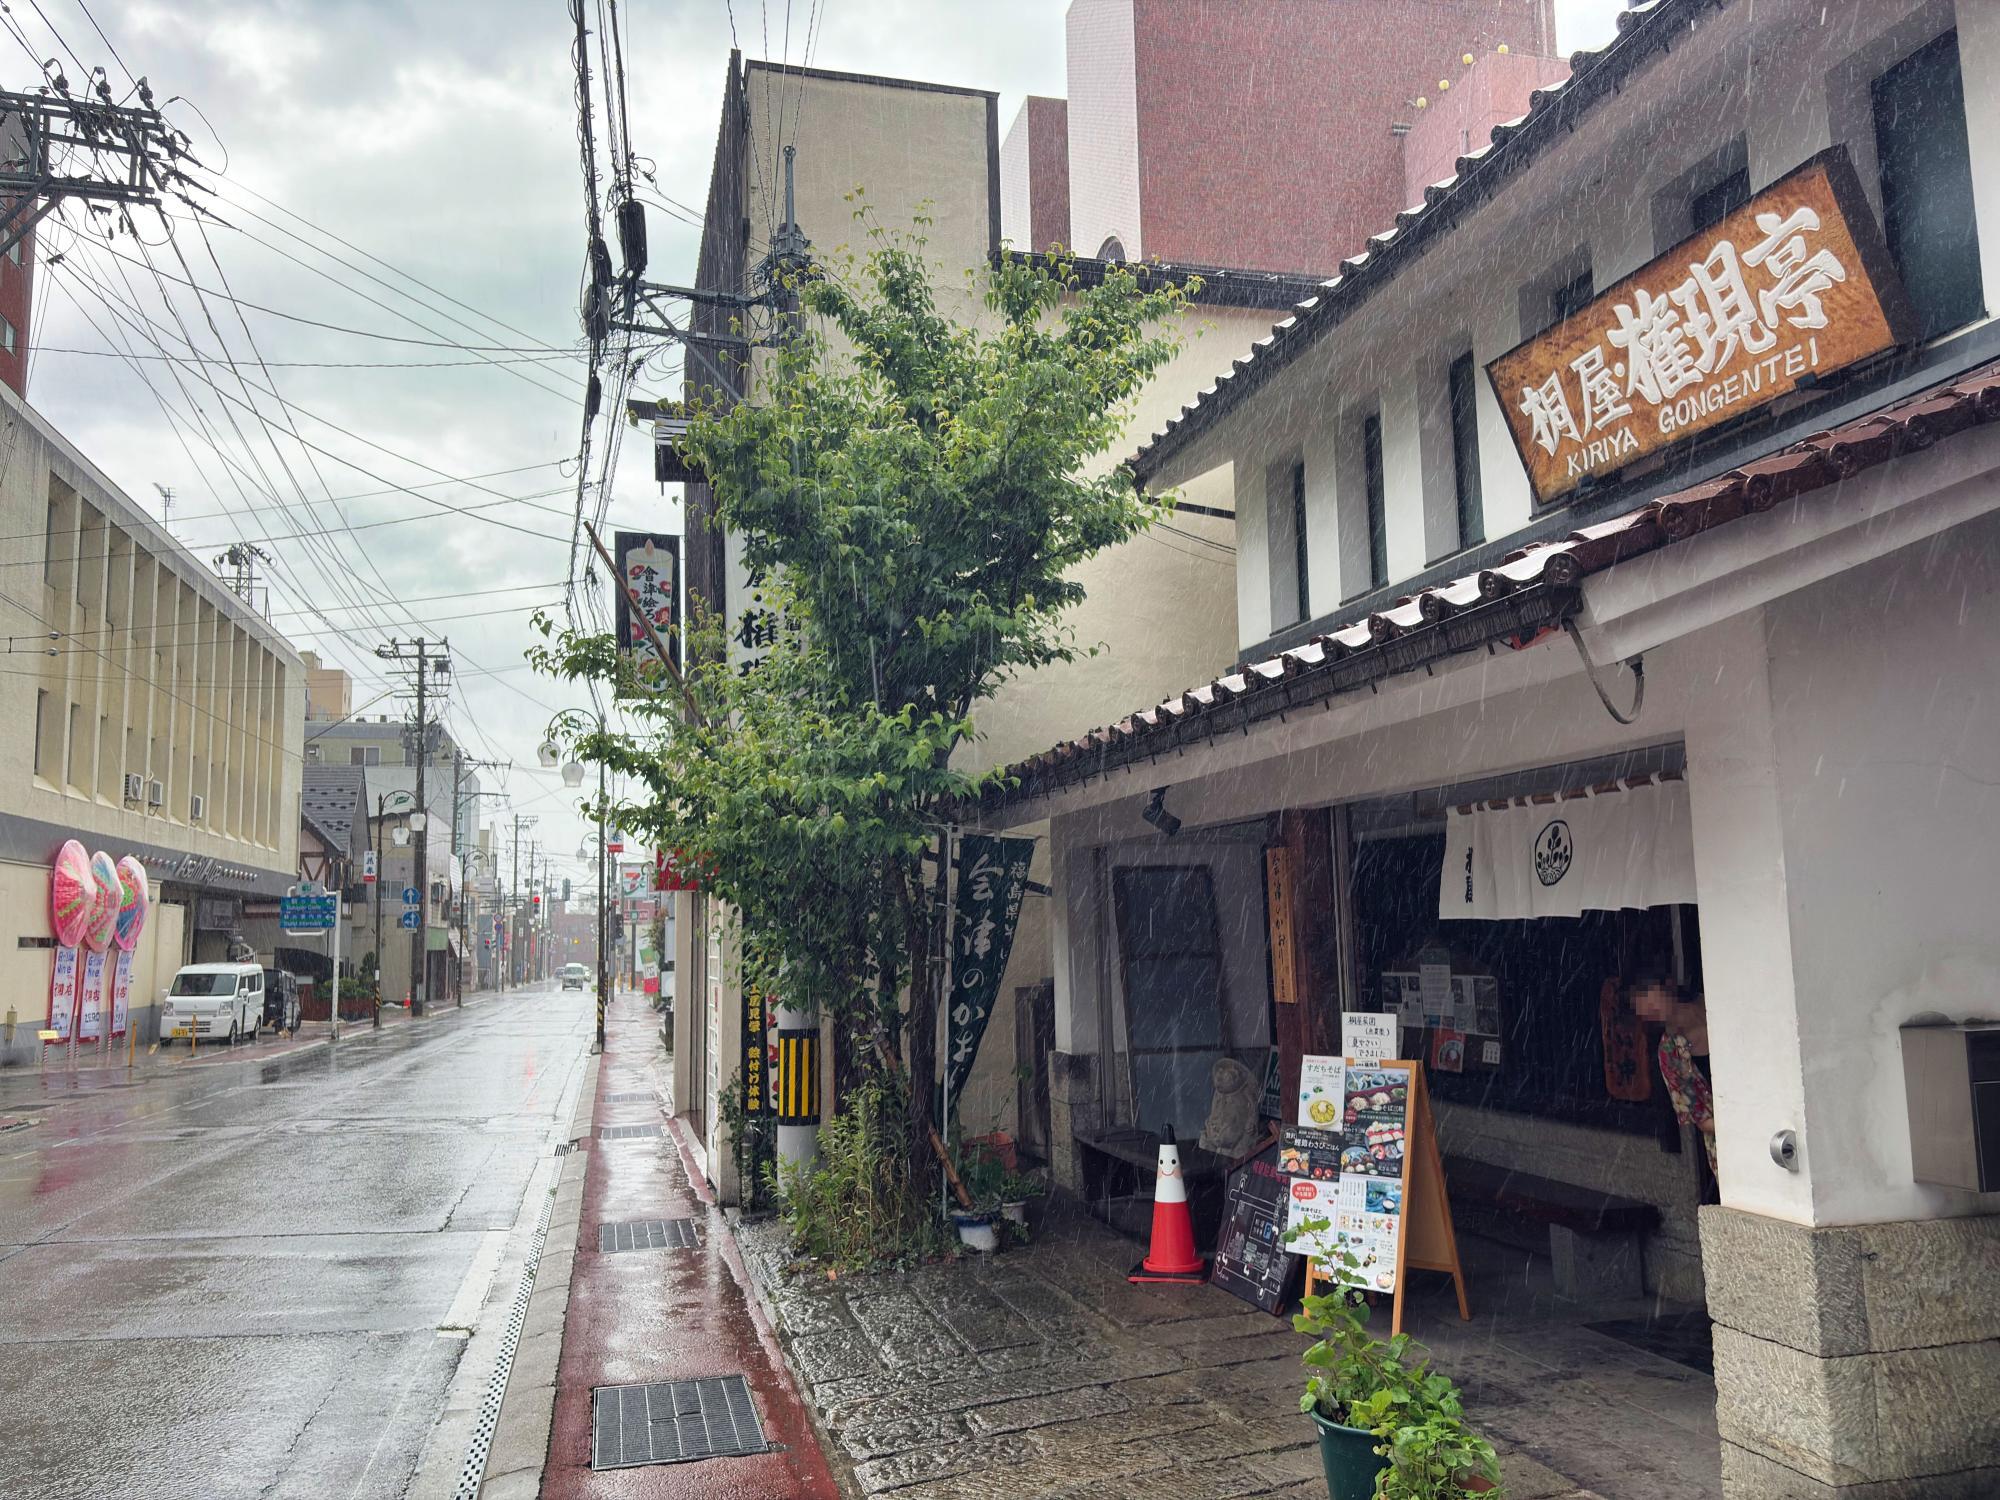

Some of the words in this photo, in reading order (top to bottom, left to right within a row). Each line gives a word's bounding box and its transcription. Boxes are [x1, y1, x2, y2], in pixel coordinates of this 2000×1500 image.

[1566, 429, 1639, 478] KIRIYA
[1658, 337, 1819, 434] GONGENTEI
[642, 565, 660, 657] 會津絵ろく
